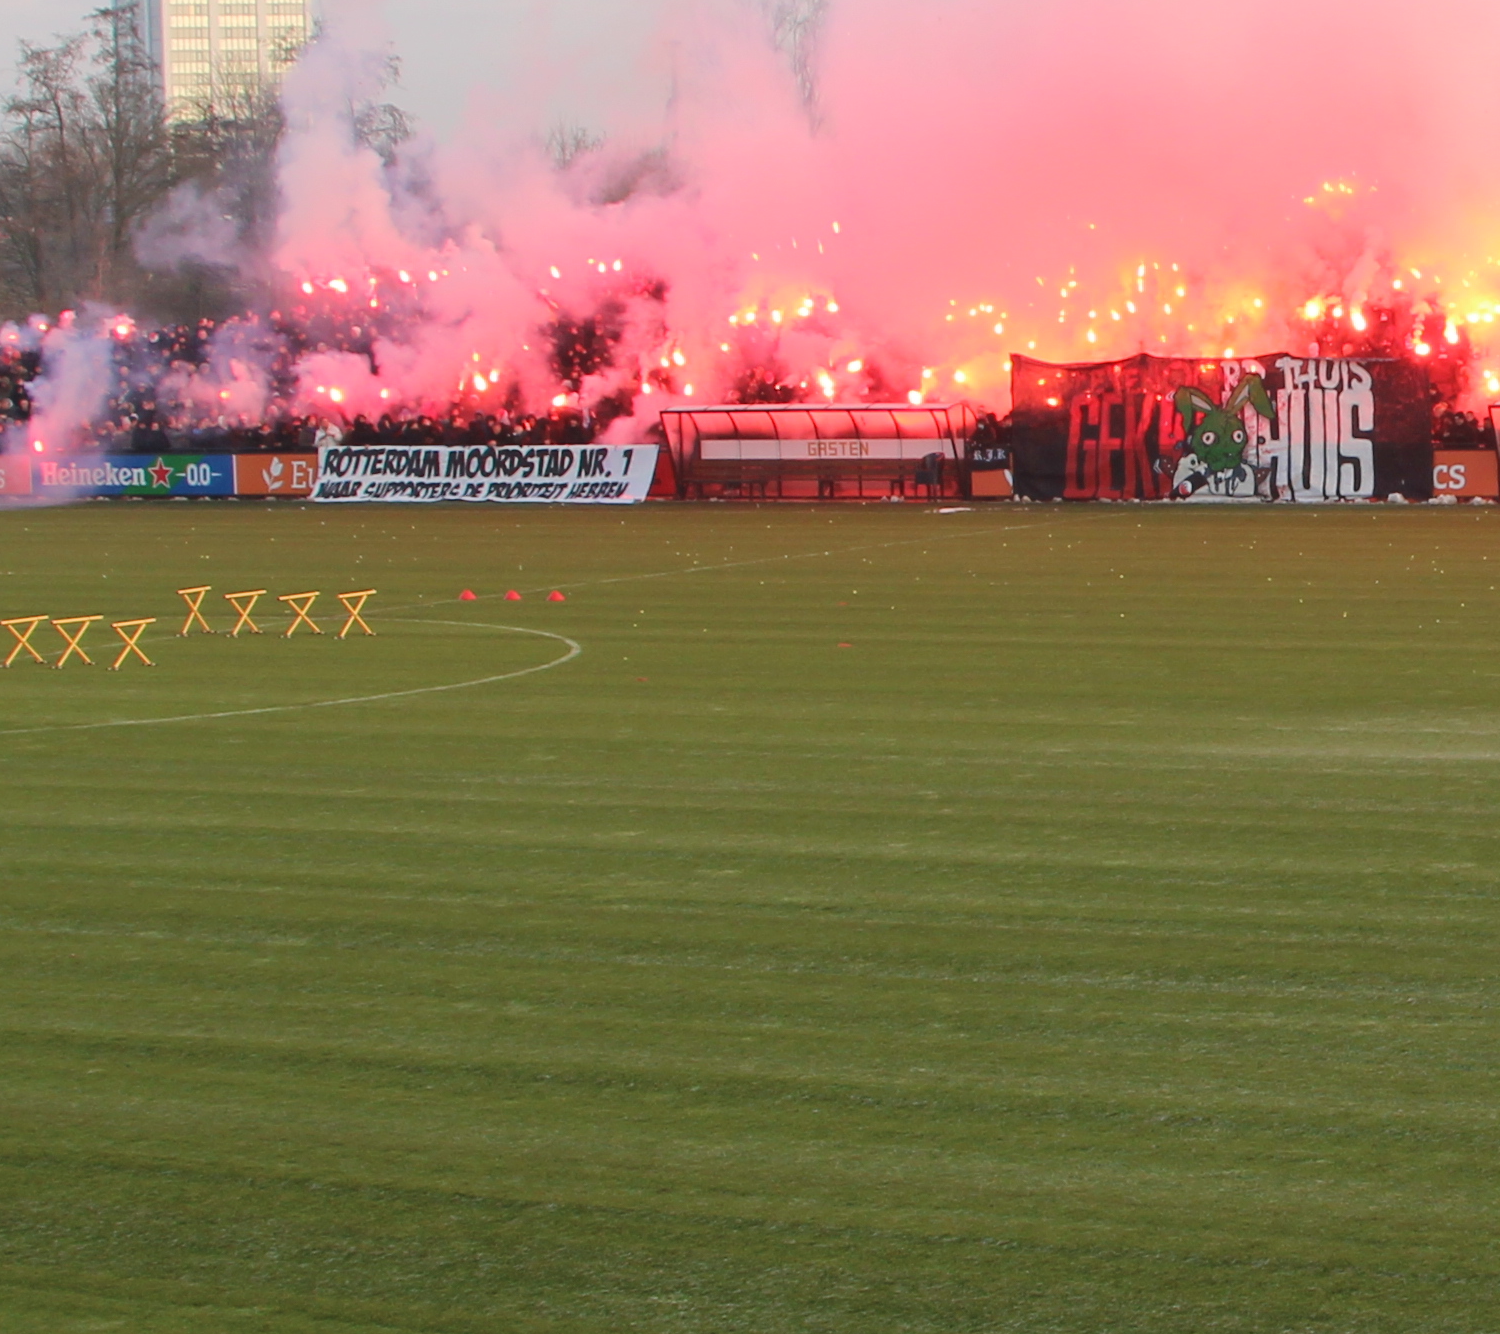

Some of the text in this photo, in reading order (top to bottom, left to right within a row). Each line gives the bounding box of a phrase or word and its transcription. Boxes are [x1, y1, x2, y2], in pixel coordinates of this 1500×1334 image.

[1276, 356, 1373, 394] THUIS
[807, 441, 869, 457] GASTEN
[41, 462, 146, 486] Heineken
[322, 446, 633, 479] ROTTERDAM MOORDSTAD NR. 1
[363, 480, 460, 499] SUPPORTERS
[463, 482, 484, 498] DE
[566, 480, 629, 499] HEBBEN
